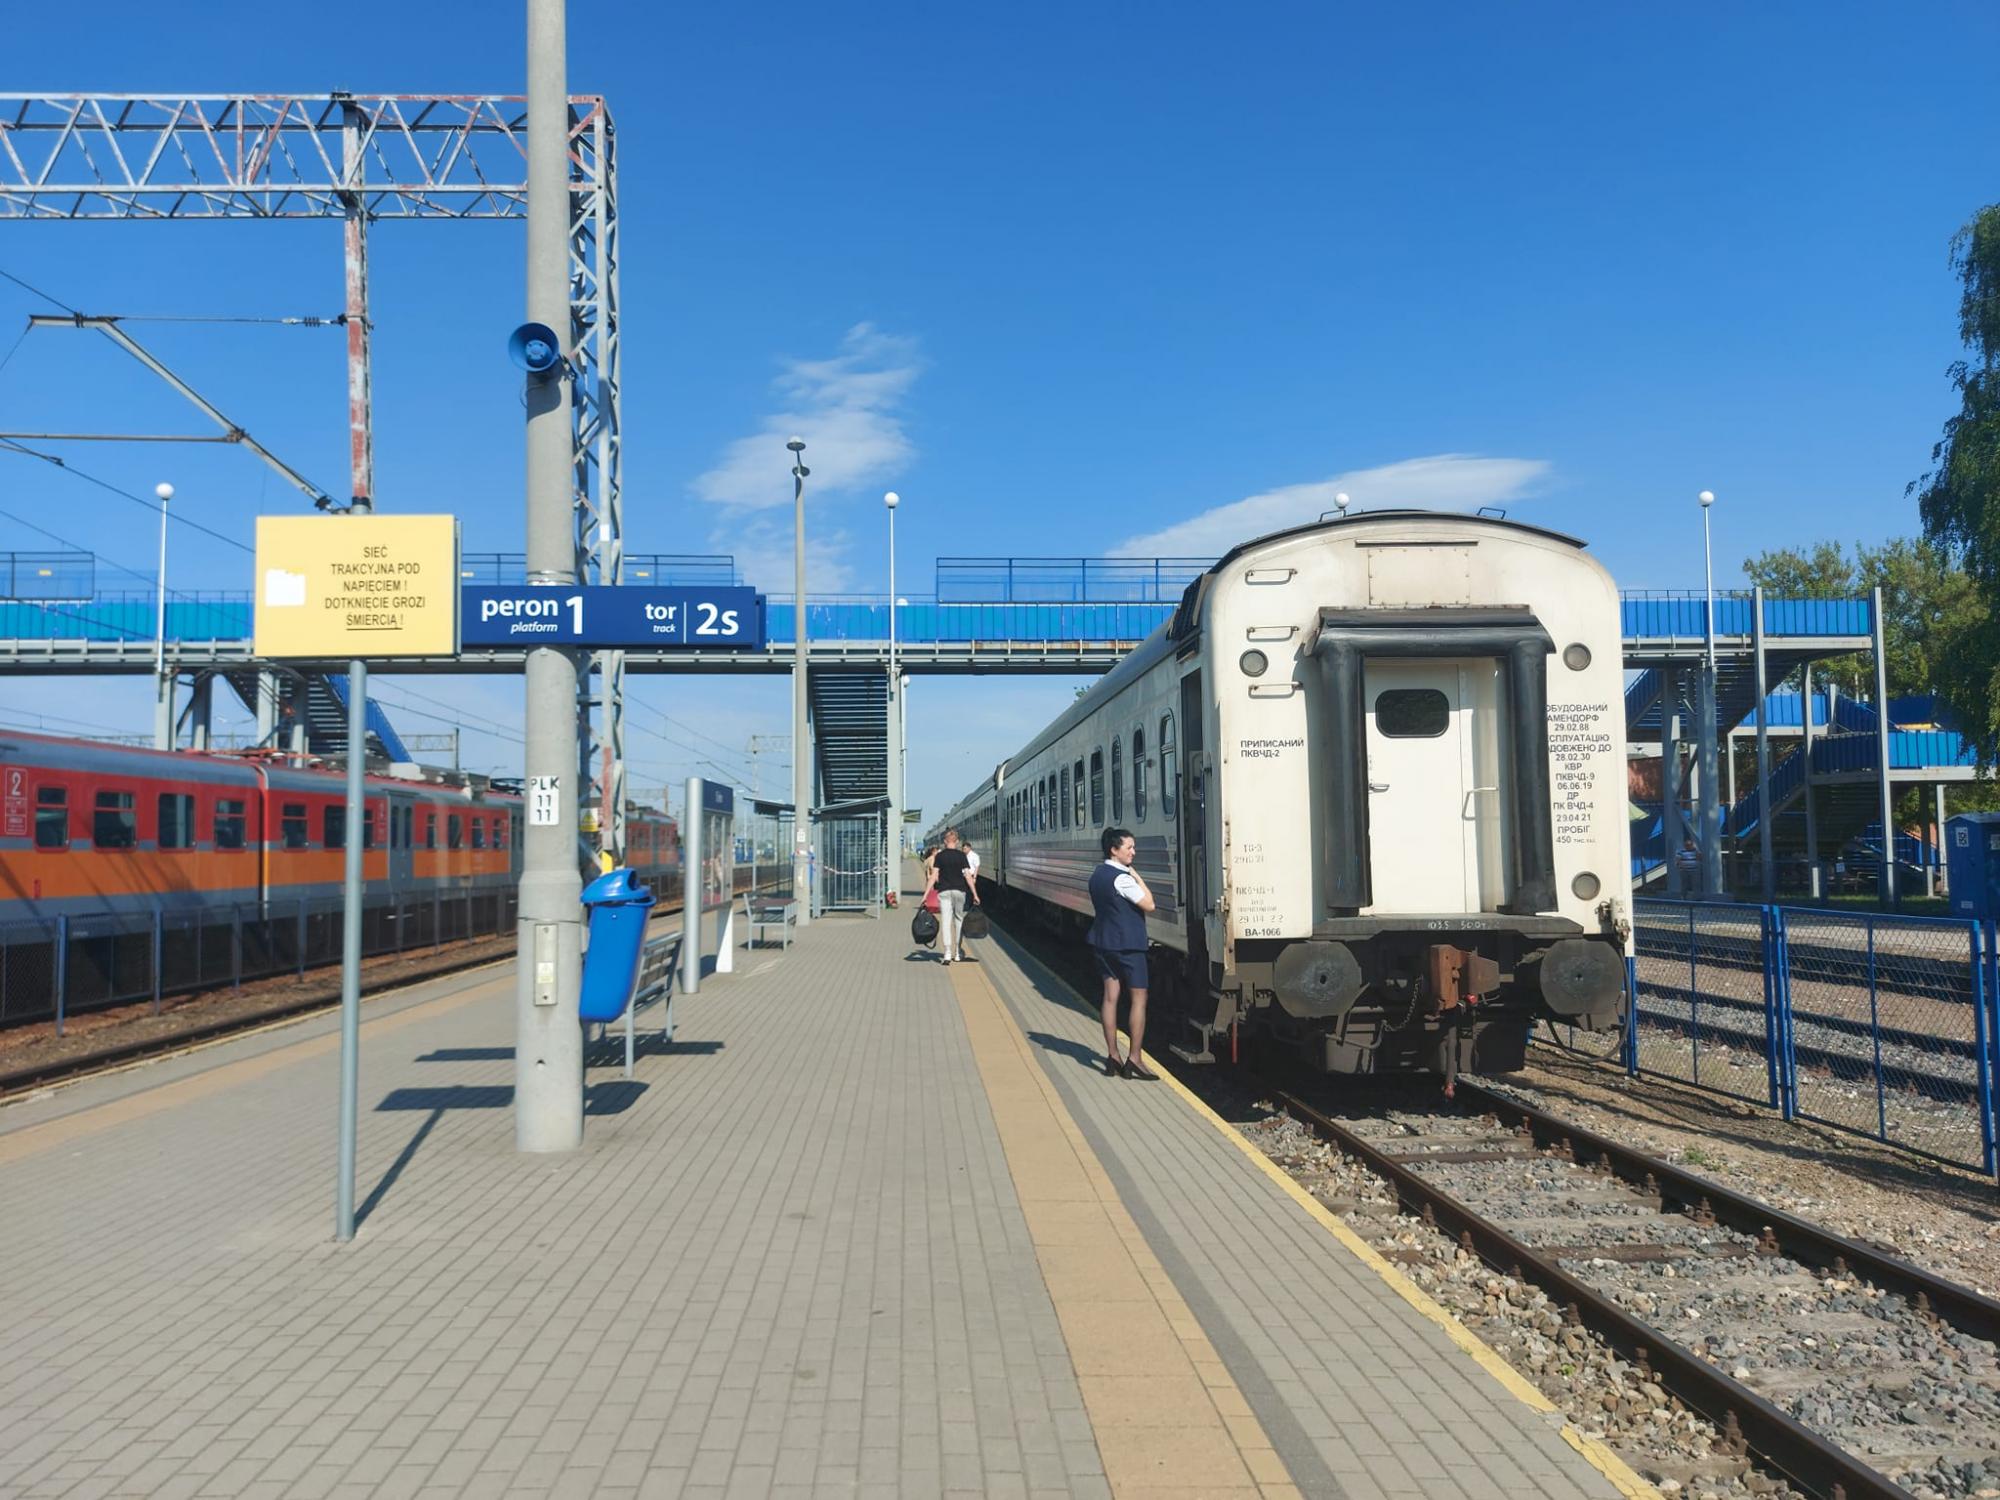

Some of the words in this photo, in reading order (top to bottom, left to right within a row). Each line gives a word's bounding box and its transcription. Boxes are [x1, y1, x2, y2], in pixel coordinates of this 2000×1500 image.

[363, 544, 388, 558] SIEĆ
[331, 563, 395, 575] TRAKCYJNA
[397, 562, 421, 575] POD
[343, 580, 401, 594] NAPIĘCIEM
[325, 597, 389, 611] DOTKNIĘCIE
[392, 596, 426, 609] GROZI
[346, 611, 398, 628] ŚMIERCIĄ
[481, 599, 558, 621] peron
[566, 596, 584, 635] 1
[645, 603, 676, 620] tor
[696, 603, 739, 635] 2s
[510, 621, 558, 634] platform
[653, 624, 676, 633] track
[1240, 738, 1304, 748] ПРИПИСАНИЙ
[1547, 734, 1610, 743] СПЛУАТАЦІЮ
[1240, 749, 1280, 758] ПКВЧД-2
[1548, 744, 1596, 753] ДОВЖЕНО
[1598, 744, 1612, 753] ДО
[1564, 762, 1582, 771] КВР
[11, 771, 21, 796] 2
[531, 776, 559, 790] PLK
[1557, 782, 1592, 790] 06.06.19
[1566, 792, 1579, 800] ДР
[1557, 825, 1590, 834] ПРОБІГ
[1556, 835, 1572, 843] 450
